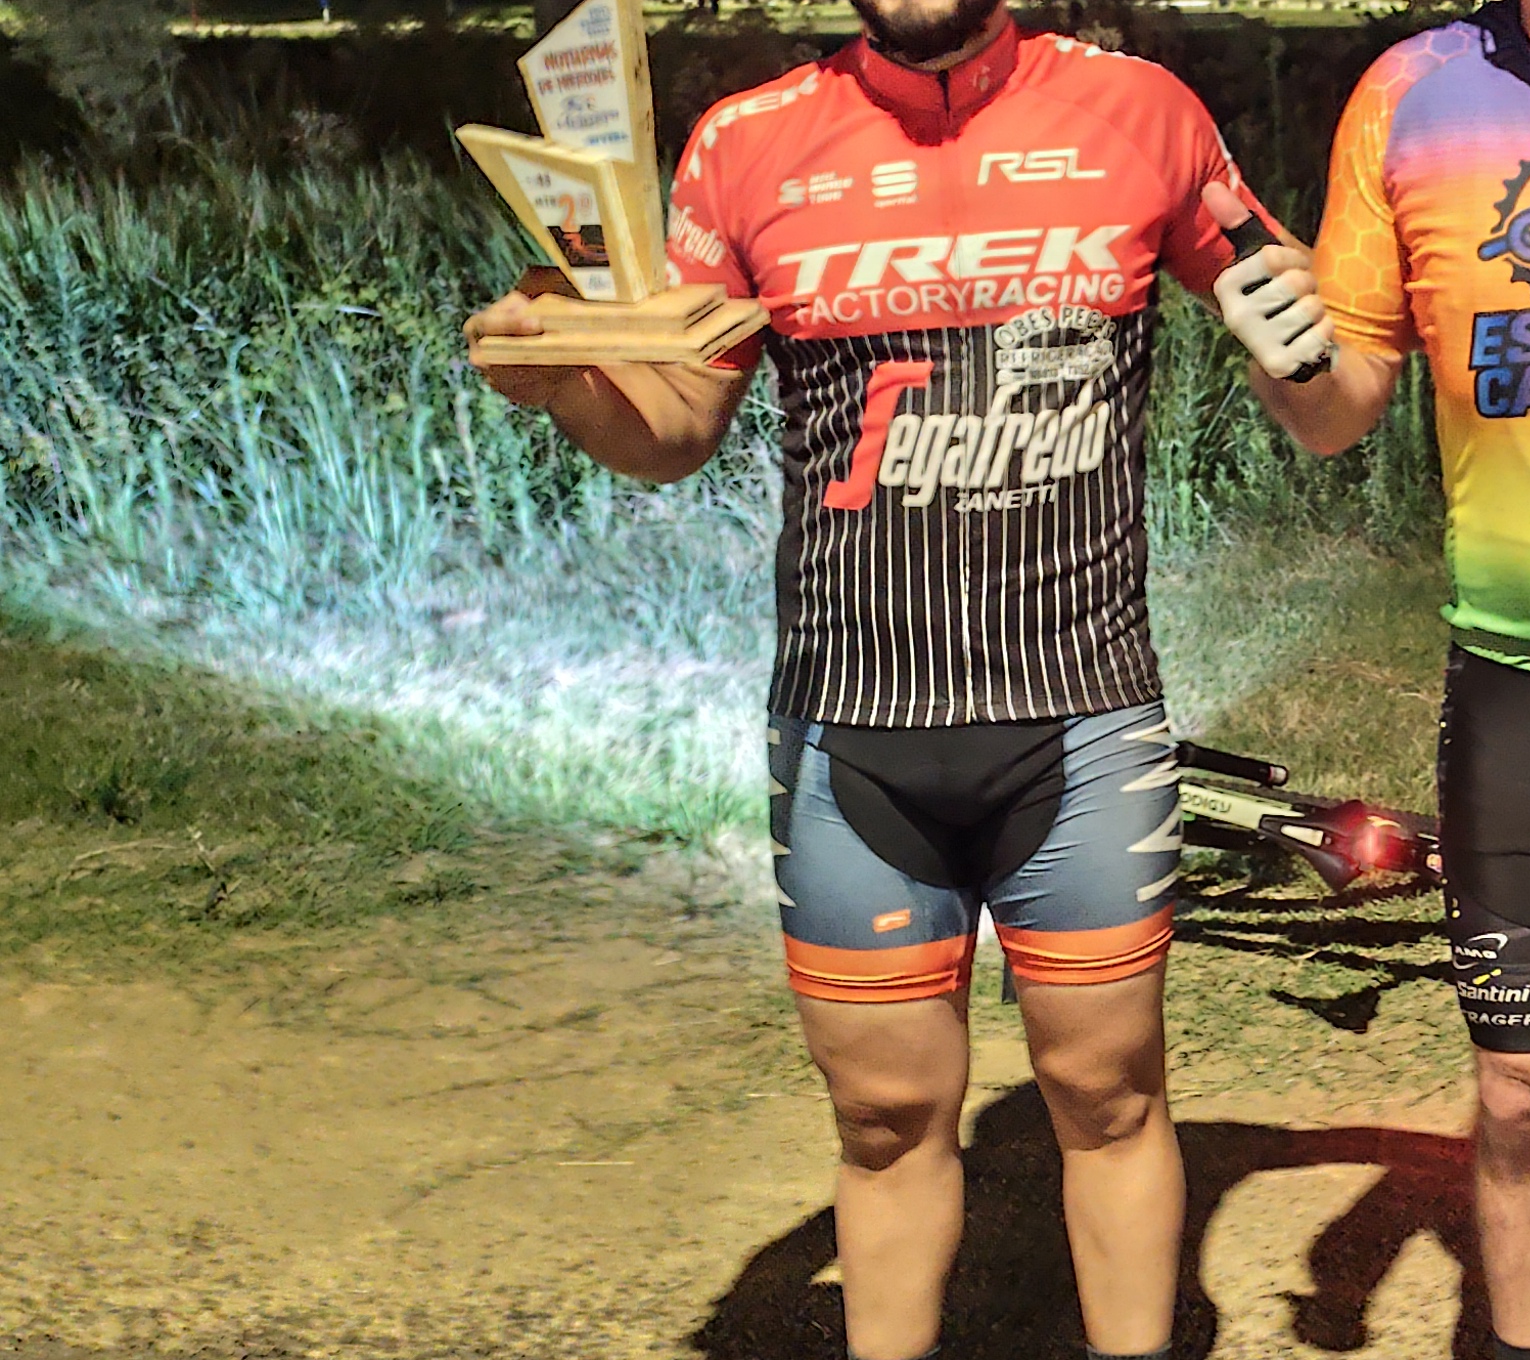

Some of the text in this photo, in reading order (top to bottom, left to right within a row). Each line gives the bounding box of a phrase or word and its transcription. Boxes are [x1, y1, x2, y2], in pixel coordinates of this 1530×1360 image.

[976, 147, 1106, 185] RSL
[777, 225, 1132, 297] TREK
[953, 484, 1058, 513] ZANETTI
